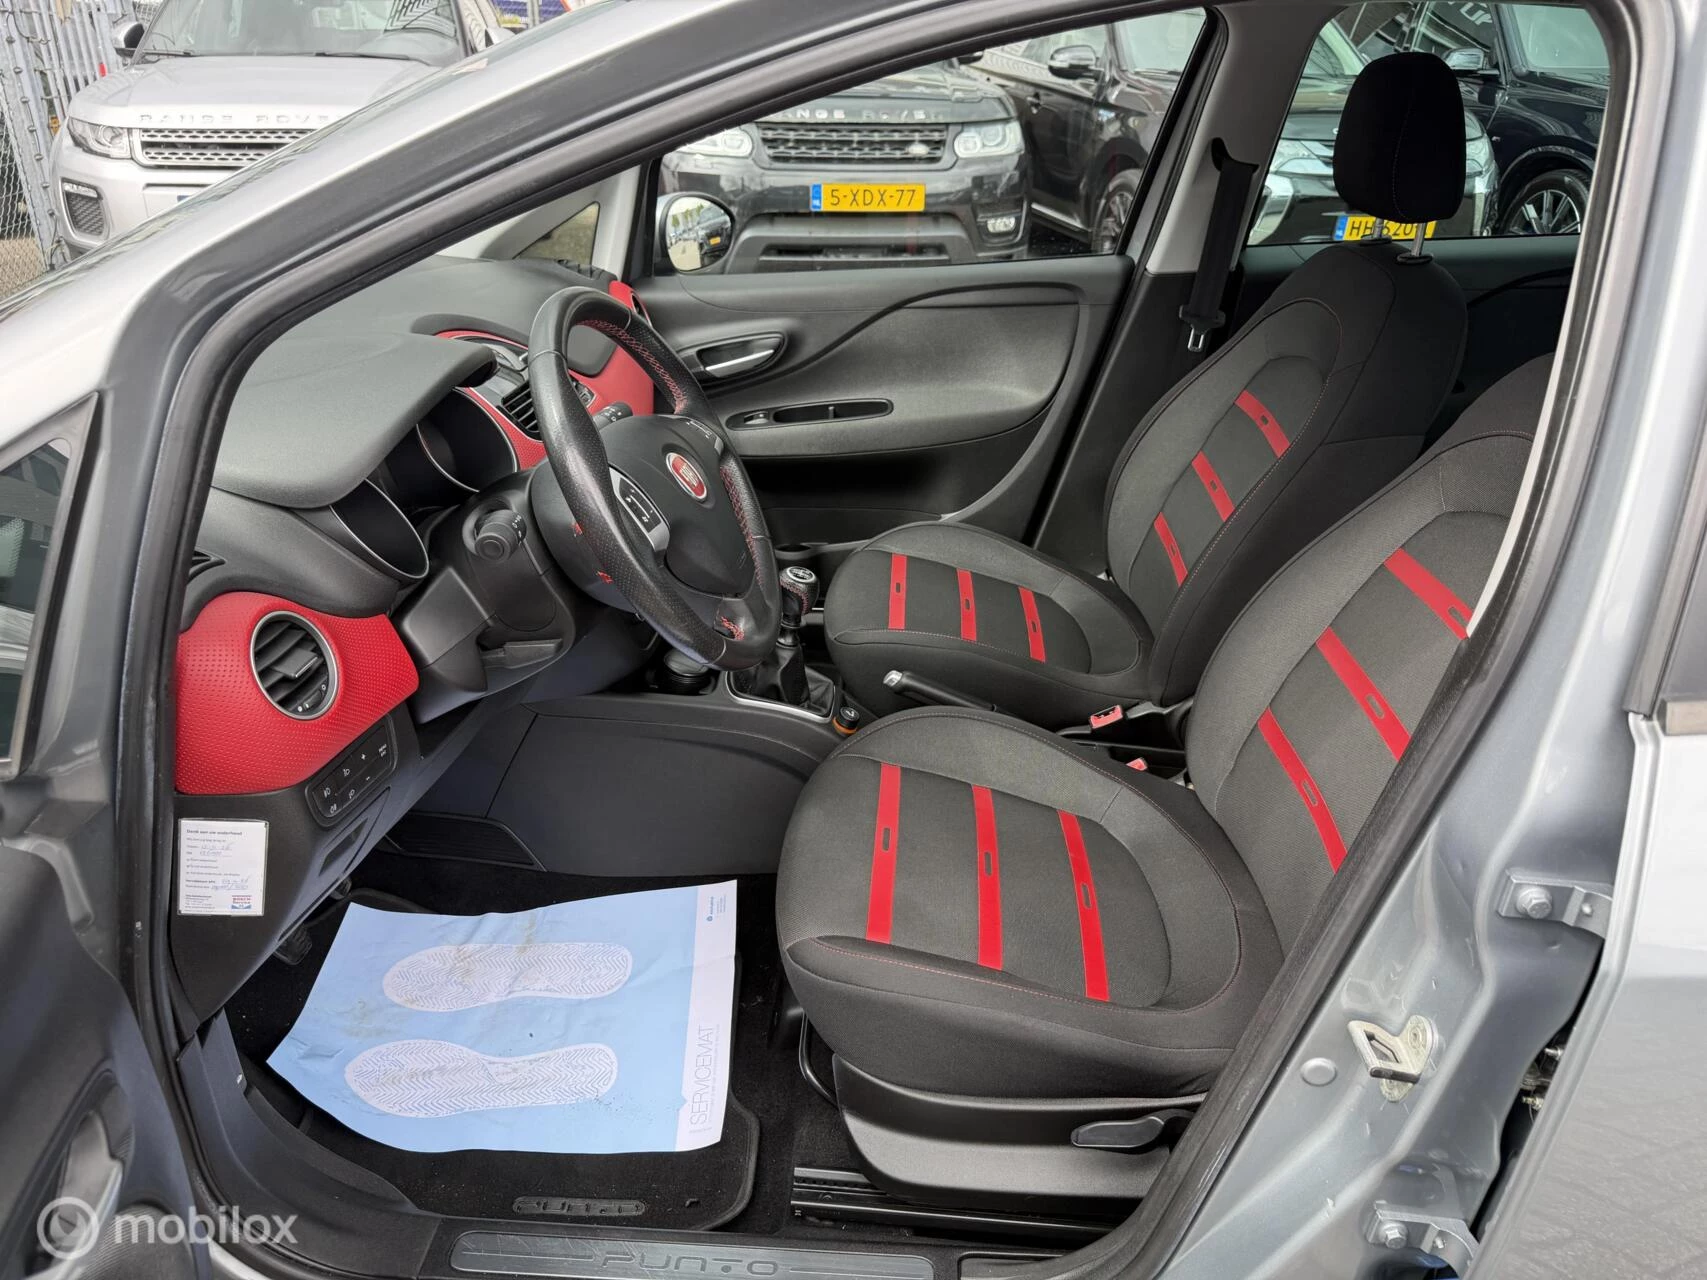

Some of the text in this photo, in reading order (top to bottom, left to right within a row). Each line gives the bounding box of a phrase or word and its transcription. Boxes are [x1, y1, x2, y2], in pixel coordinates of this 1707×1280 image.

[139, 113, 343, 124] RANGE ROVE
[768, 109, 846, 120] ANGE
[830, 188, 916, 207] 5-XDX-77
[690, 1024, 714, 1126] SERVICEMAT
[602, 1252, 779, 1276] PUNTO
